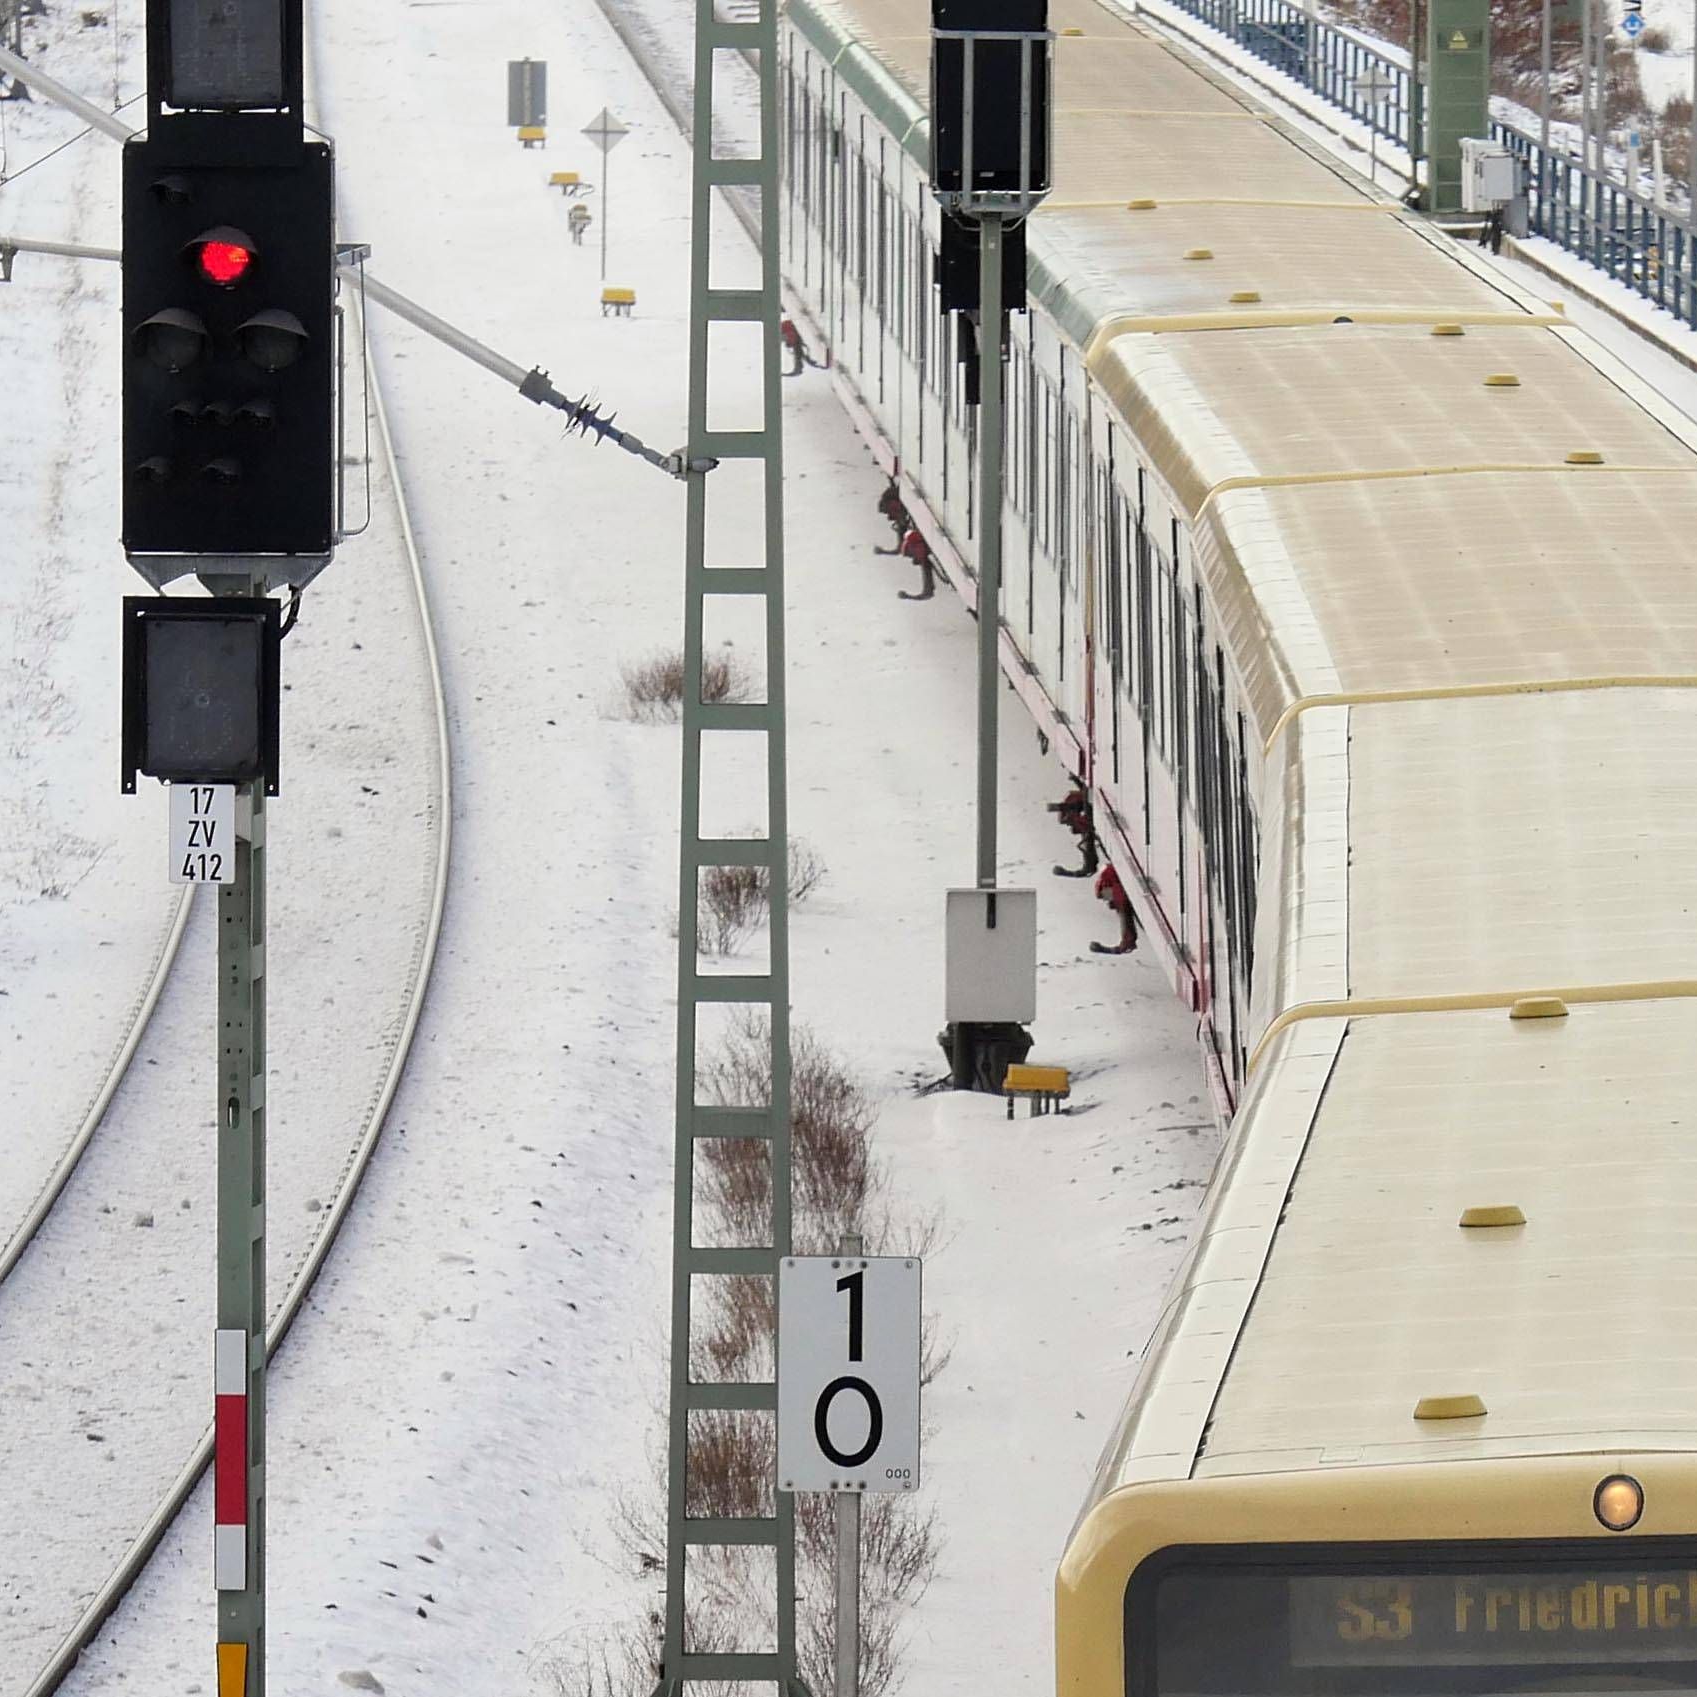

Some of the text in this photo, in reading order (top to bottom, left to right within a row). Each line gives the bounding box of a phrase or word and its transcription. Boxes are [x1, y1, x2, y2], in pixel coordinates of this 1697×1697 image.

[190, 786, 215, 814] 17
[187, 820, 216, 848] ZV
[182, 852, 222, 881] 412
[836, 1271, 863, 1362] 1
[814, 1375, 883, 1468] 0
[1337, 1580, 1414, 1641] S3
